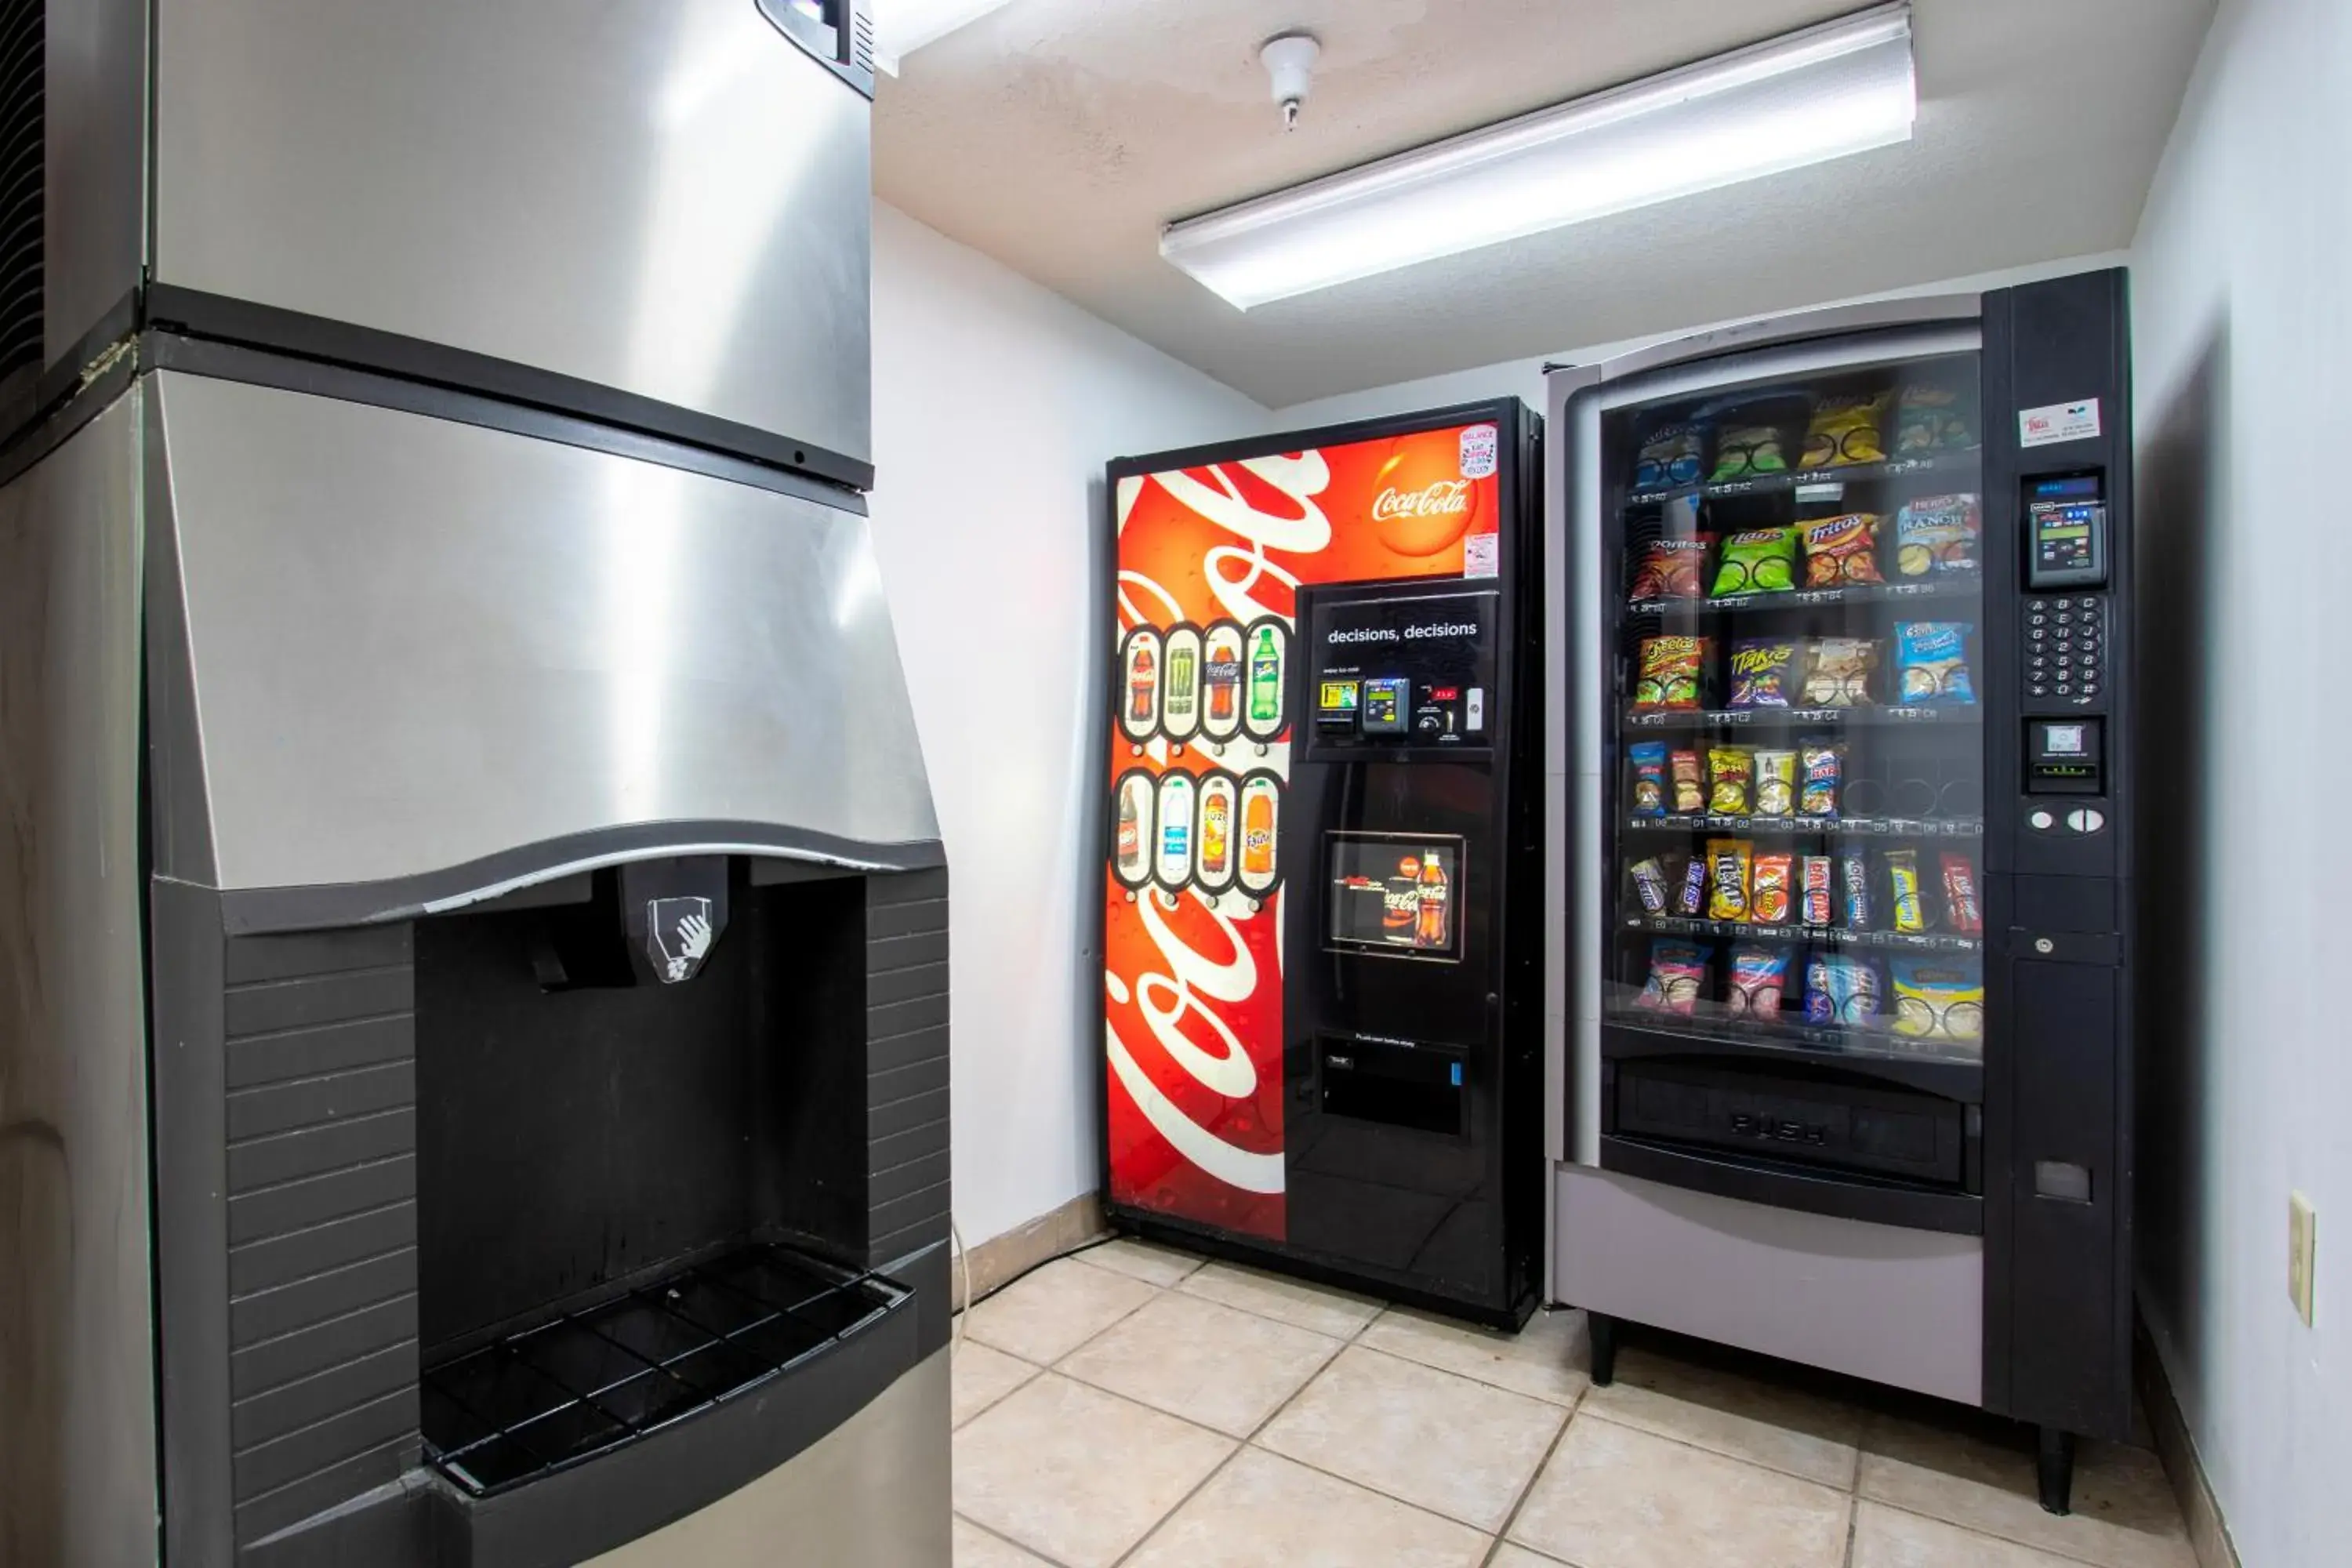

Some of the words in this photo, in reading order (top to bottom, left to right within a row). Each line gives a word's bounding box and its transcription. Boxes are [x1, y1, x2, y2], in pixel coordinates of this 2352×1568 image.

[1372, 479, 1470, 521] Coca-Cola
[1651, 539, 1707, 551] Doritos
[2033, 601, 2042, 610] A
[2058, 600, 2068, 608] B
[2084, 598, 2093, 607] C
[2033, 615, 2042, 624] D
[2058, 614, 2068, 622] E
[2083, 612, 2092, 621] F
[1328, 629, 1399, 644] decisions,
[1404, 622, 1477, 640] decisions
[2033, 630, 2043, 638] G
[2059, 628, 2069, 637] H
[2083, 627, 2092, 636] J
[1693, 819, 1704, 828] D1
[1731, 1116, 1826, 1147] PUSH
